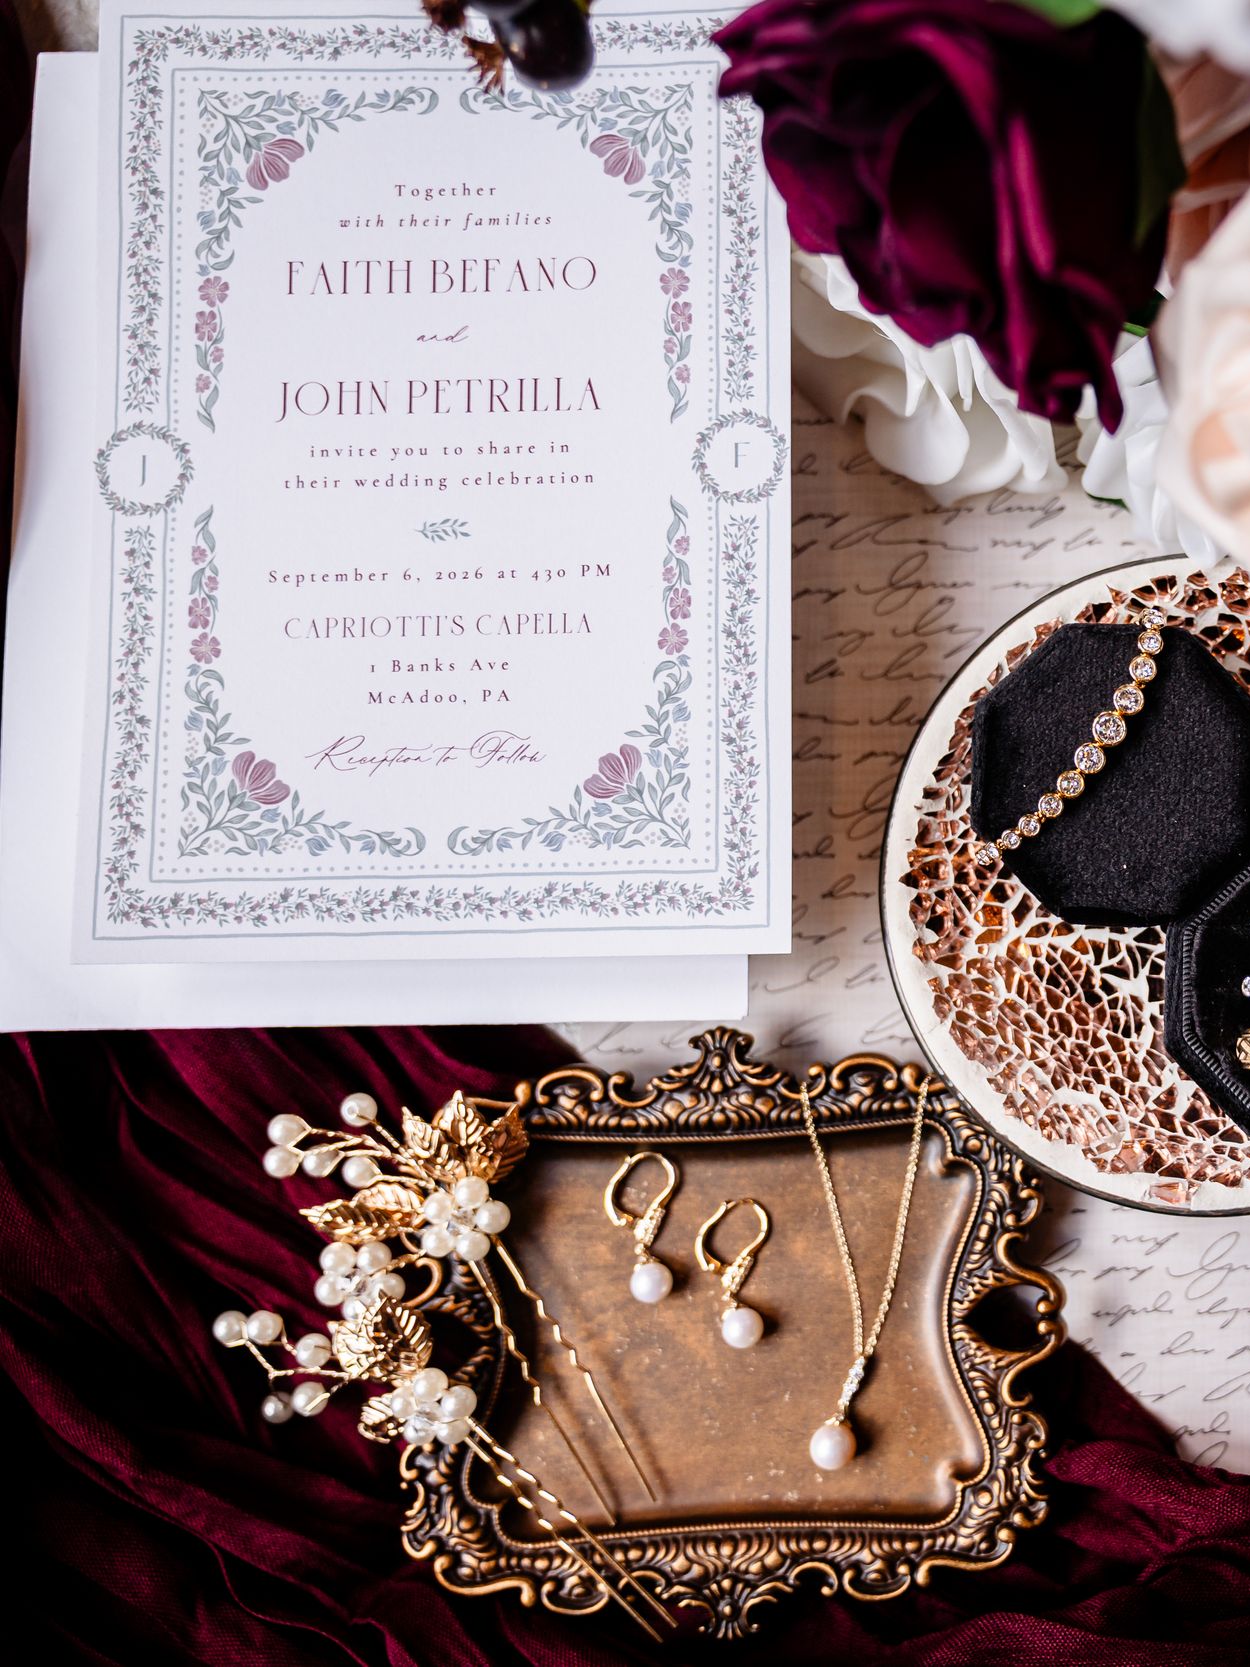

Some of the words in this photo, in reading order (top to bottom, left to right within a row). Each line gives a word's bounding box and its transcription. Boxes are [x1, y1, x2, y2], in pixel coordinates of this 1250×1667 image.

[394, 182, 497, 202] Together
[339, 213, 384, 228] with
[398, 213, 452, 228] their
[462, 211, 552, 232] families
[287, 259, 413, 296] FAITH
[430, 256, 597, 294] BEFANO
[416, 324, 470, 344] and
[275, 380, 389, 423] JOHN
[407, 376, 601, 415] PETRILLA
[310, 444, 378, 458] invite
[390, 447, 428, 462] you
[442, 446, 463, 456] to
[477, 440, 536, 455] share
[550, 441, 569, 454] in
[733, 440, 751, 470] F
[284, 474, 341, 489] their
[354, 472, 448, 492] wedding
[461, 470, 594, 487] celebration
[268, 567, 389, 588] September
[402, 568, 421, 583] 6,
[435, 566, 484, 581] 2026
[497, 569, 517, 579] at
[531, 568, 566, 583] 430
[580, 563, 610, 577] PM
[284, 614, 465, 639] CAPRIOTTI'S
[475, 612, 592, 636] CAPELLA
[369, 662, 378, 674] 1
[391, 657, 456, 673] Banks
[469, 658, 509, 672] Ave
[367, 688, 467, 705] McAdoo,
[482, 689, 511, 703] PA
[304, 734, 434, 777] Reception
[433, 744, 467, 768] to
[468, 729, 547, 769] Follow
